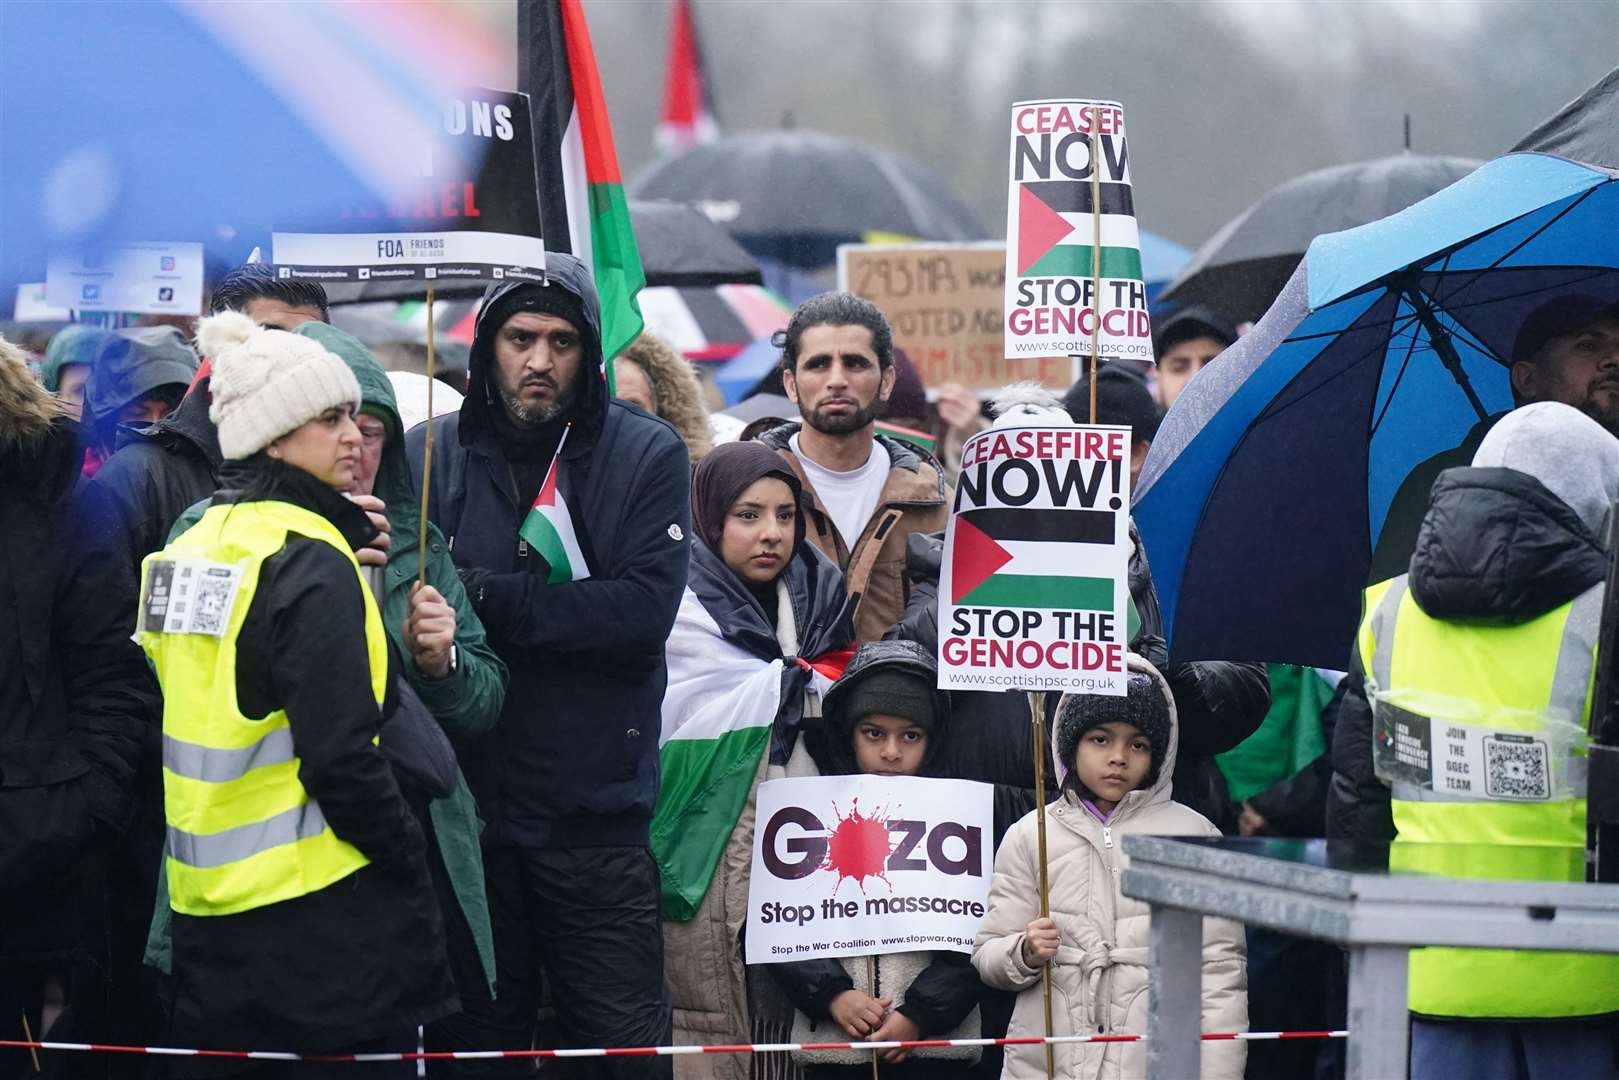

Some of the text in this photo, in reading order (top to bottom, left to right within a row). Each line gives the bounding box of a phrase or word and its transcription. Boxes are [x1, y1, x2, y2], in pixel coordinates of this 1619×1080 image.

[377, 240, 404, 258] FOA
[410, 239, 445, 249] FRIENDS
[1109, 281, 1146, 309] TH
[1009, 308, 1150, 337] GENOCID
[962, 432, 1123, 469] CEASEFIRE
[953, 458, 1122, 513] NOW!
[951, 608, 1114, 642] STOP THE
[942, 637, 1122, 672] GENOCIDE
[949, 673, 1115, 690] www.scottishpsc.org.uk
[1446, 727, 1466, 740] JOIN
[1449, 743, 1464, 757] THE
[1446, 776, 1471, 790] TEAM
[760, 896, 985, 926] Stop the massacre
[771, 945, 793, 955] Stop
[796, 944, 810, 952] the
[812, 942, 830, 951] War
[833, 938, 876, 950] Coalition
